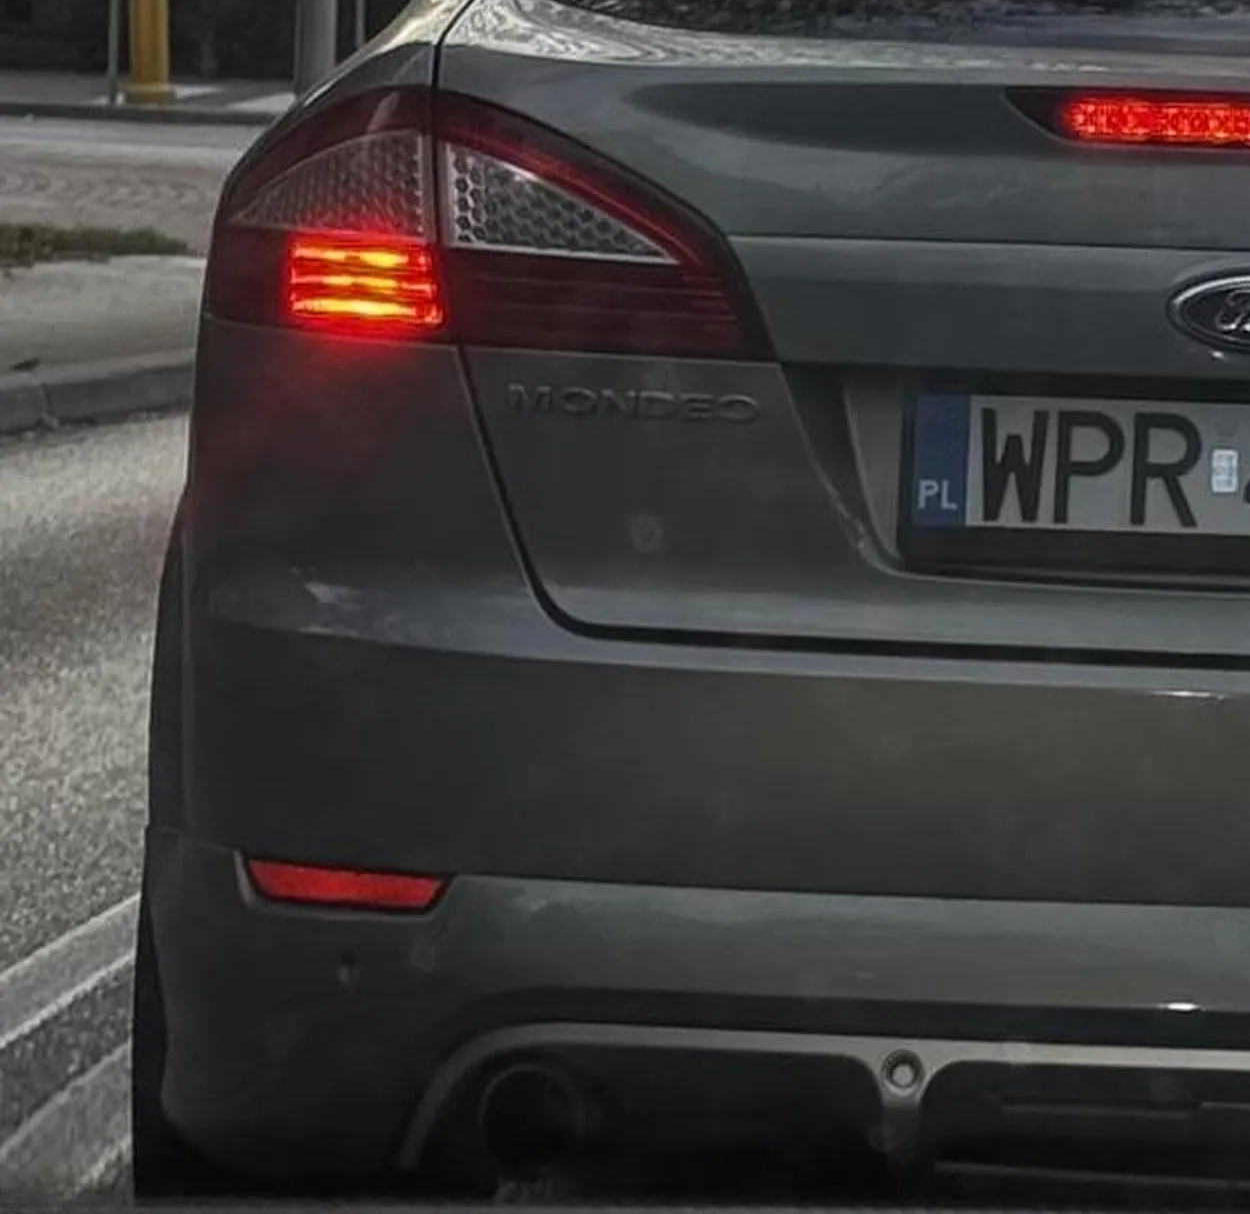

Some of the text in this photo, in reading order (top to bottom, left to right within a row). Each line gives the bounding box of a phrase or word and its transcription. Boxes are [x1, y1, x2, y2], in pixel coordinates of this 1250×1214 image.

[507, 383, 758, 424] MONDEO
[981, 407, 1203, 528] WPR
[917, 478, 958, 510] PL
